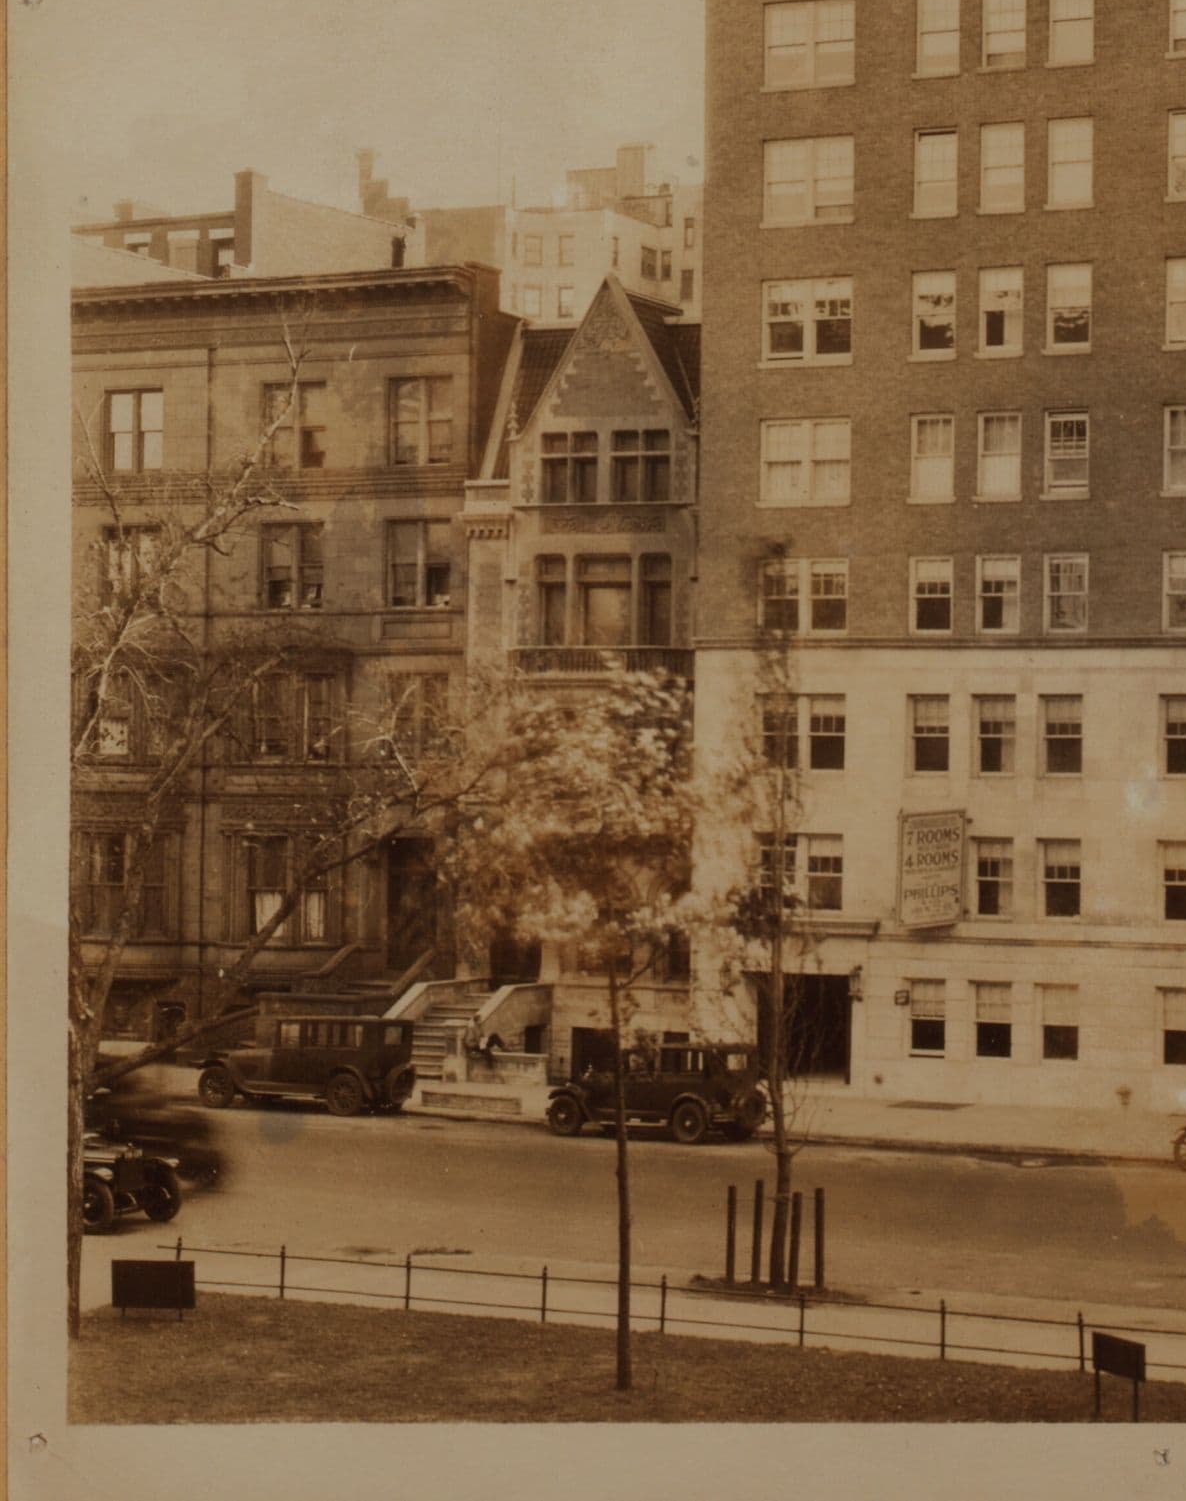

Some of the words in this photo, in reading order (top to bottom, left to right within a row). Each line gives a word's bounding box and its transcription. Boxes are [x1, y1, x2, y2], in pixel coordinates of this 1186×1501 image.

[905, 830, 914, 845] 7
[916, 827, 960, 845] ROOMS
[904, 854, 914, 868] 4
[916, 850, 959, 866] ROOMS
[904, 884, 959, 900] PHILLIPS
